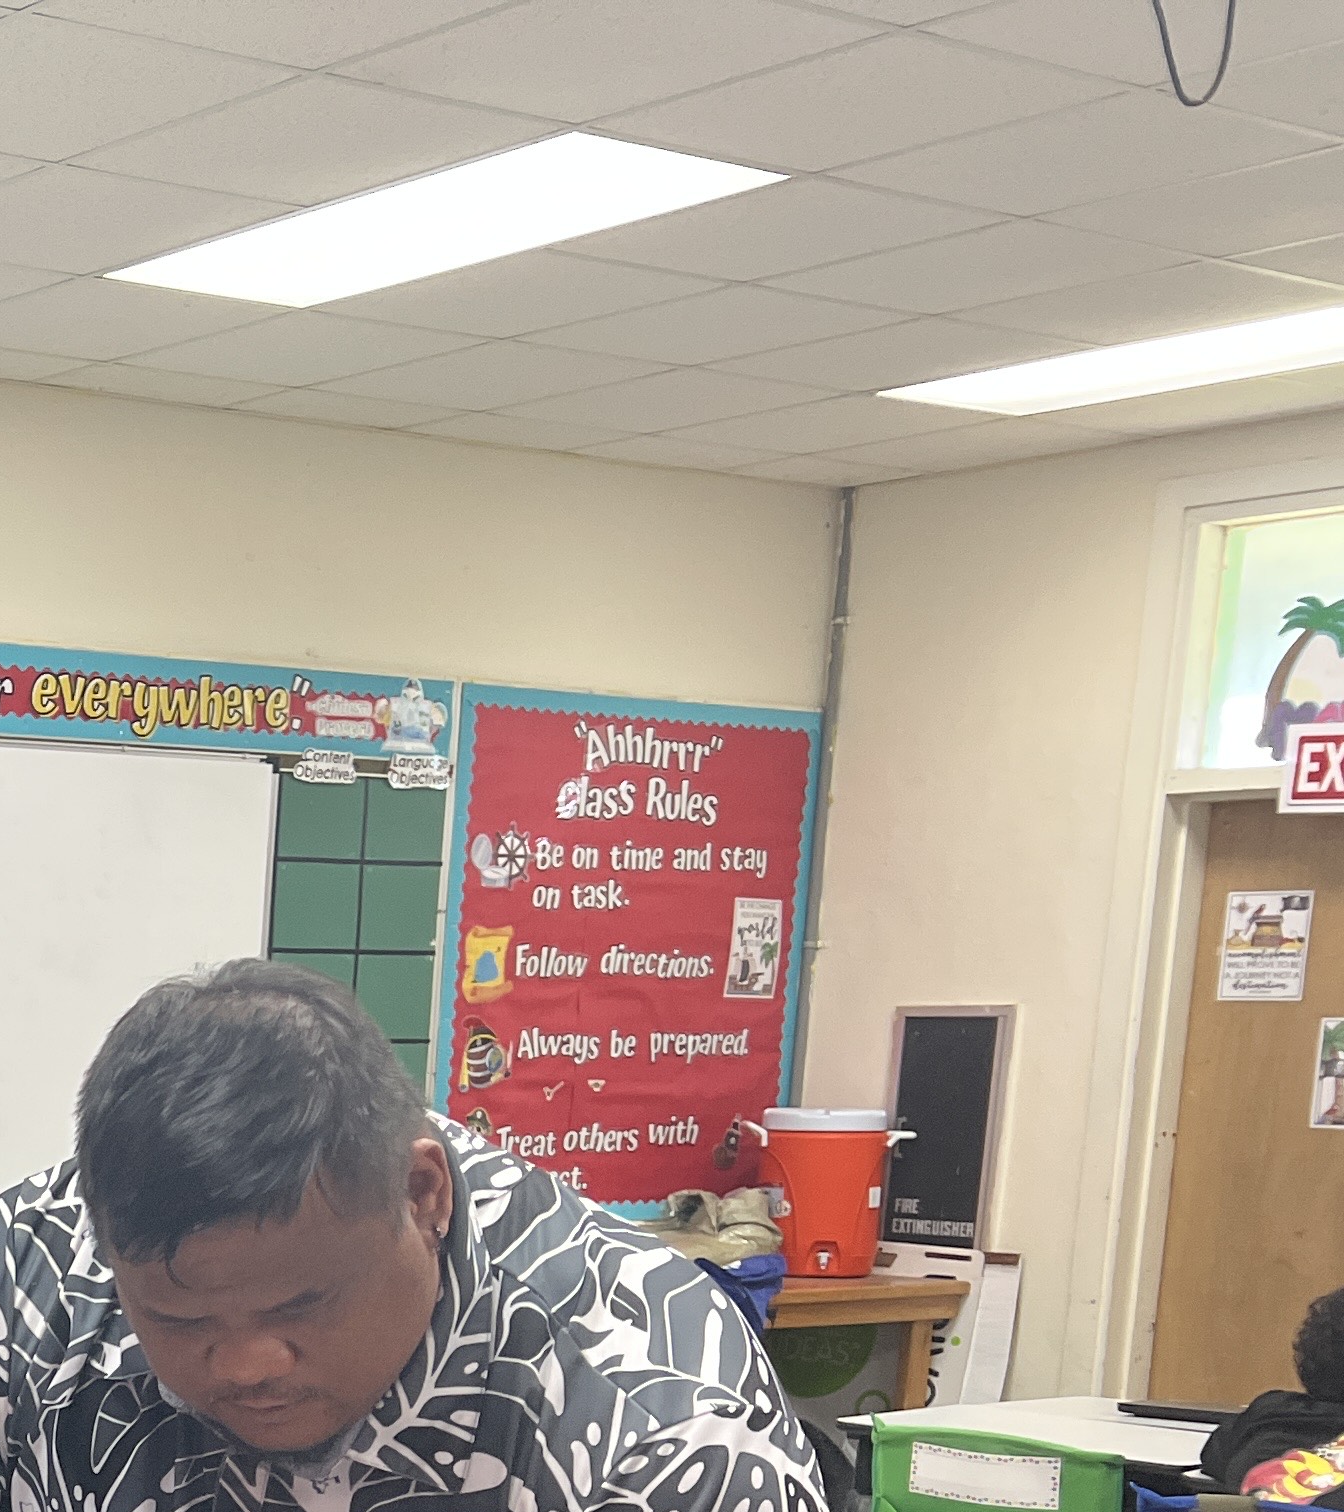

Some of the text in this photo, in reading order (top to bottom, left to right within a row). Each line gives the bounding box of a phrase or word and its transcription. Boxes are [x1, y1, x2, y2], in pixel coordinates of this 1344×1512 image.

[294, 763, 448, 786] Objectives Objectives
[304, 749, 449, 771] Content Language
[556, 775, 719, 827] Class Rules
[534, 840, 768, 879] Be on time and stay
[531, 879, 630, 910] on task.
[514, 943, 715, 979] Follow directions.
[517, 1026, 749, 1064] Always be prepared.
[495, 1115, 699, 1158] Treat others with
[894, 1197, 920, 1215] FIRE
[892, 1217, 974, 1238] EXTINGUISHER
